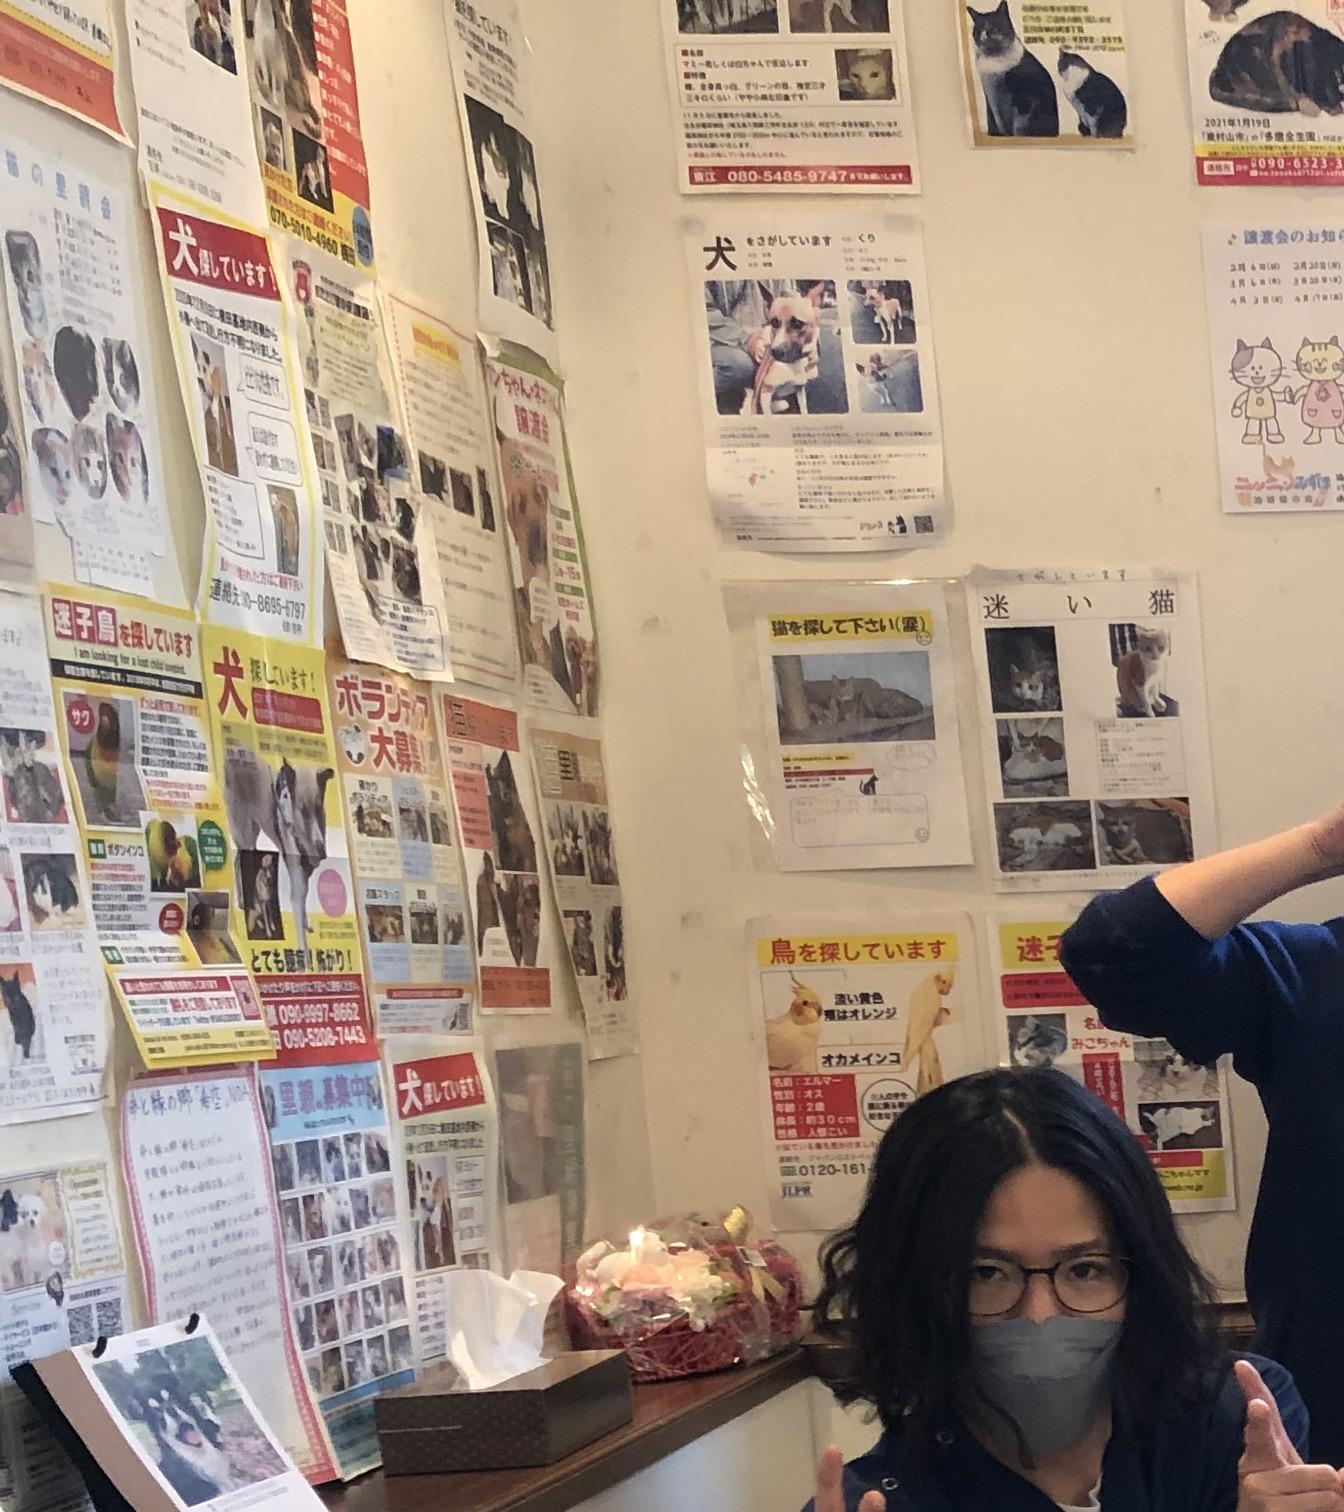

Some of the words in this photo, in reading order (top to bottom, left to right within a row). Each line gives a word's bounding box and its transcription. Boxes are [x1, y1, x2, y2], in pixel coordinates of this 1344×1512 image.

[727, 170, 847, 182] 080-5485-9747
[703, 236, 737, 271] 犬
[746, 235, 832, 247] をさがしています
[983, 588, 1175, 620] 迷い猫
[772, 616, 926, 636] 猫を探して下さい(涙)
[71, 707, 92, 726] サク
[770, 938, 947, 965] 鳥を探しています
[835, 992, 884, 1006] 淡い黄色
[821, 1052, 901, 1067] オカメインコ
